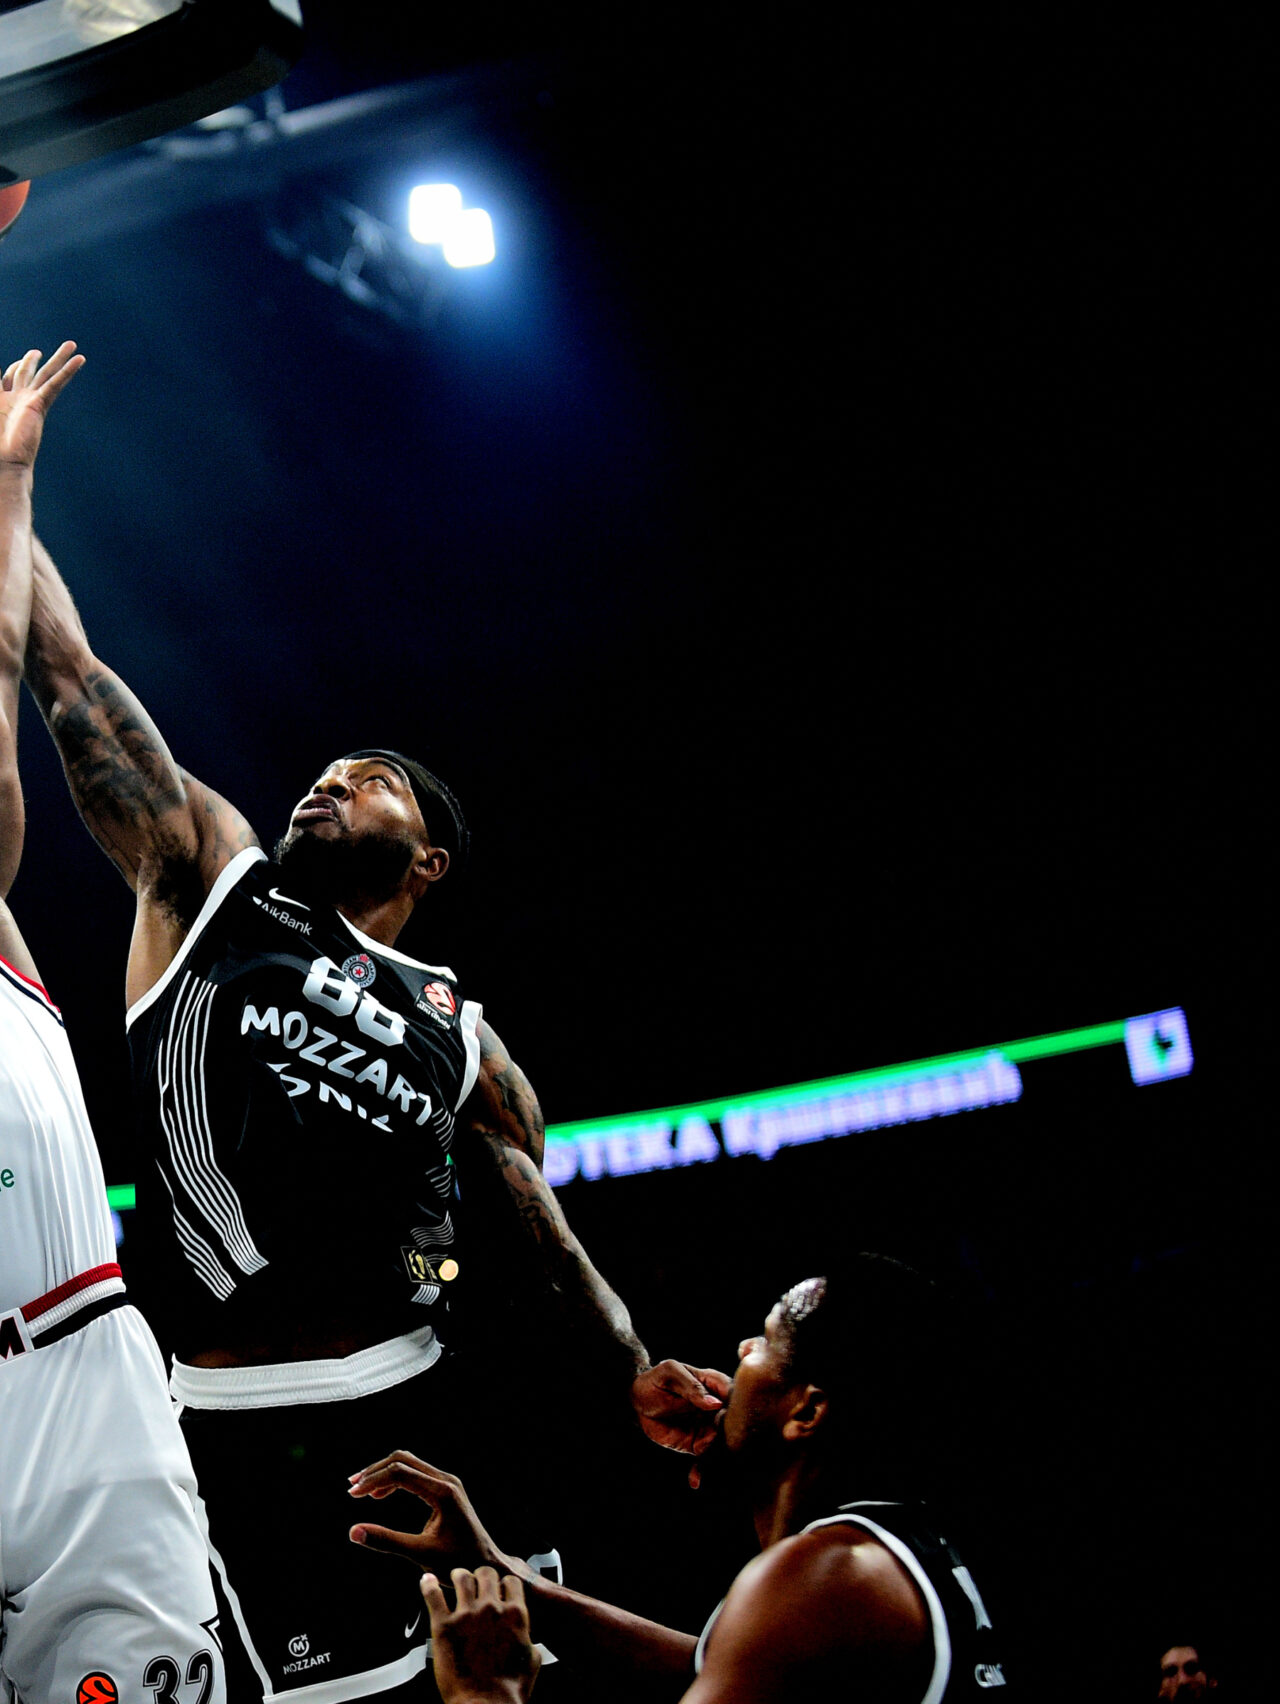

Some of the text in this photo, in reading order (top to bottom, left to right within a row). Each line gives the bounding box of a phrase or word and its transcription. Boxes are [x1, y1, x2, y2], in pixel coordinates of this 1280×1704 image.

[261, 902, 313, 936] AikBank
[240, 1004, 433, 1126] MOZZART
[282, 1652, 332, 1676] MOZZART
